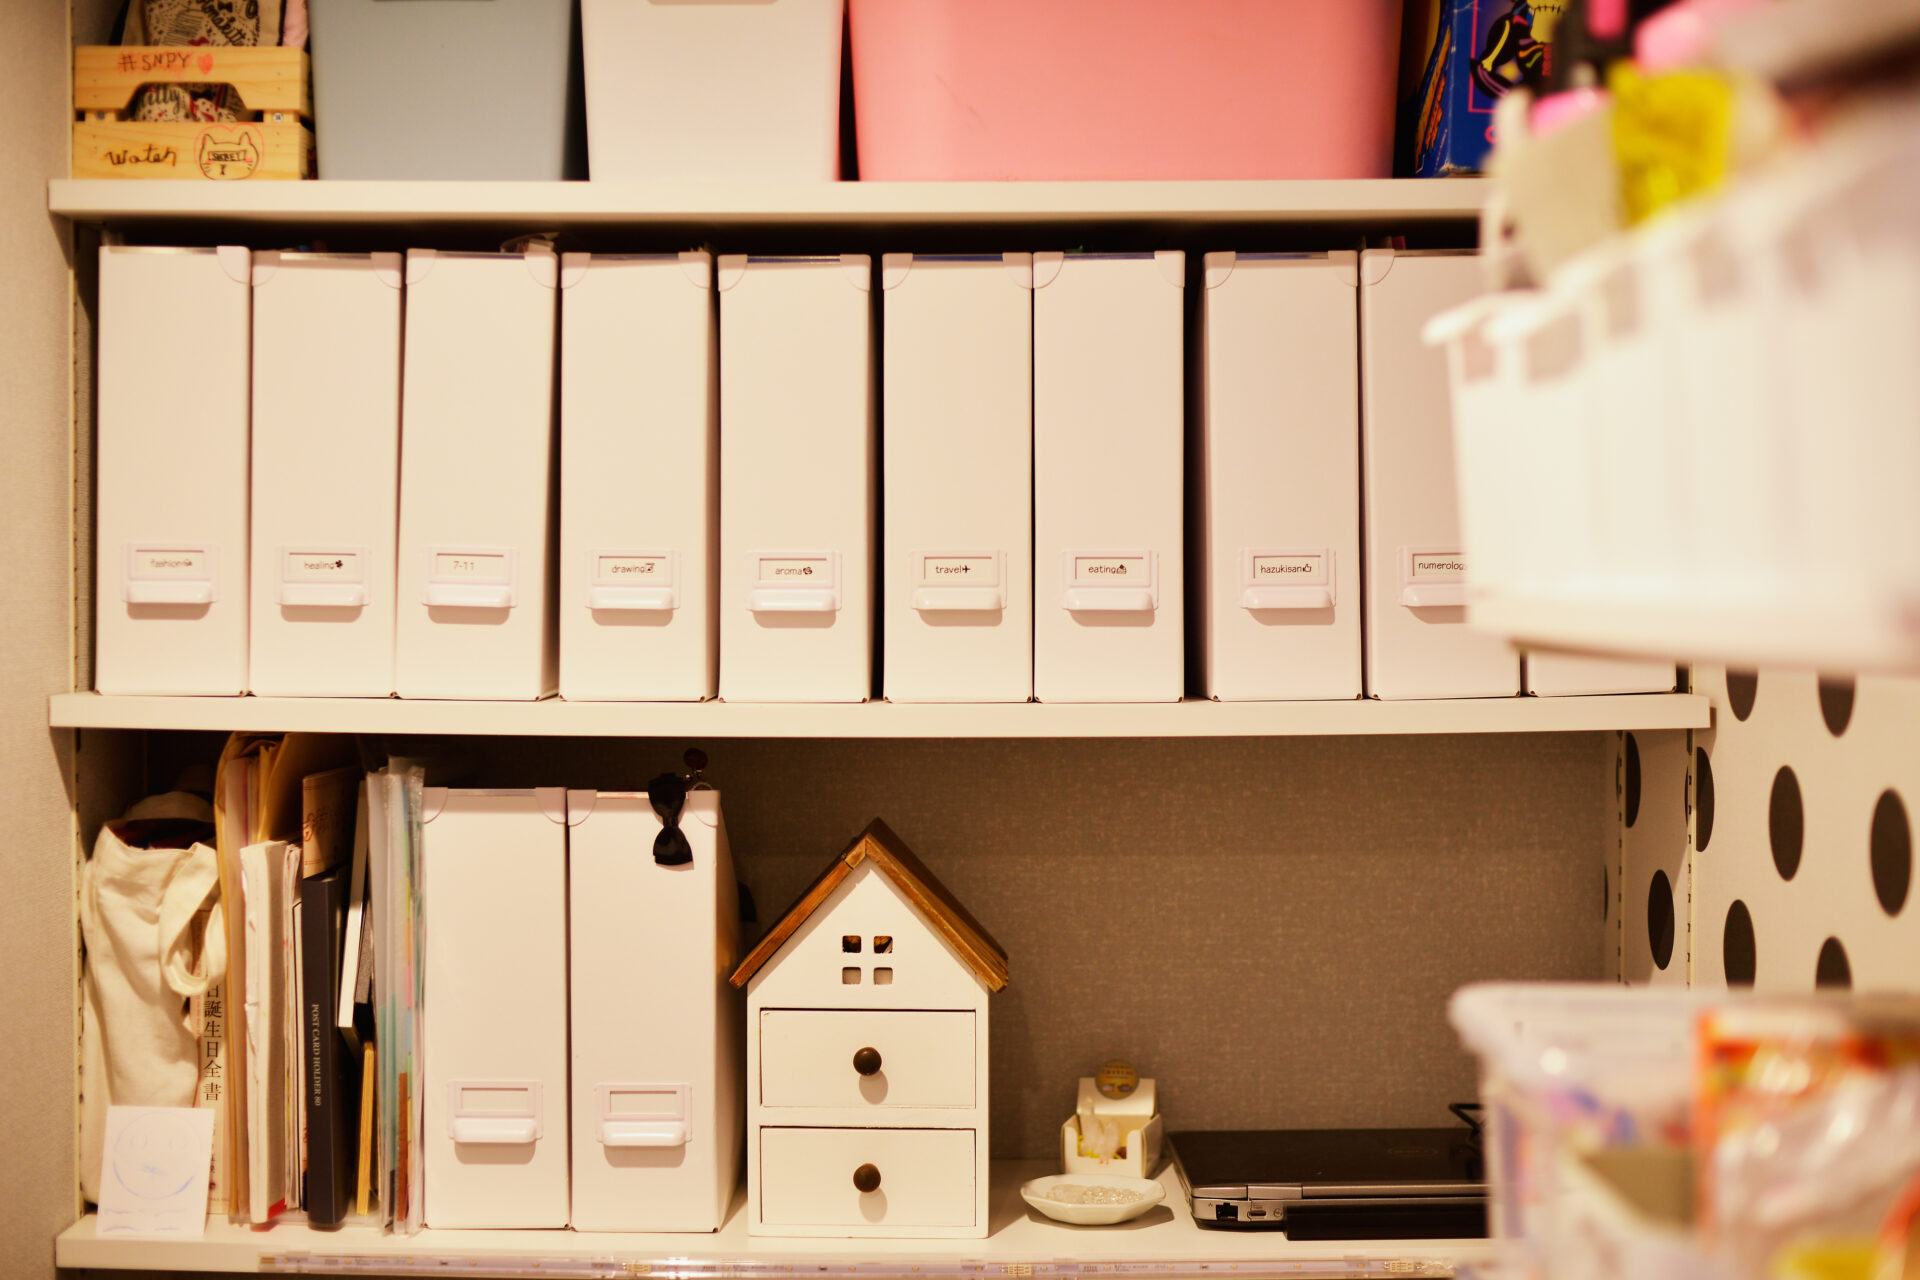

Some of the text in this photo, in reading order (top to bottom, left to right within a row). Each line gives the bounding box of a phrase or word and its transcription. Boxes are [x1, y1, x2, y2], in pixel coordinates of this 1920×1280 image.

[150, 558, 184, 568] fashion
[303, 560, 335, 571] healing
[452, 560, 475, 570] 7-11
[612, 563, 644, 573] drawing
[1260, 563, 1302, 573] hazukisan
[775, 566, 802, 575] aroma
[935, 564, 962, 574] travel
[1088, 564, 1116, 574] eating
[312, 1003, 321, 1027] POST
[312, 1029, 321, 1055] CARD
[313, 1058, 322, 1094] HOLDER
